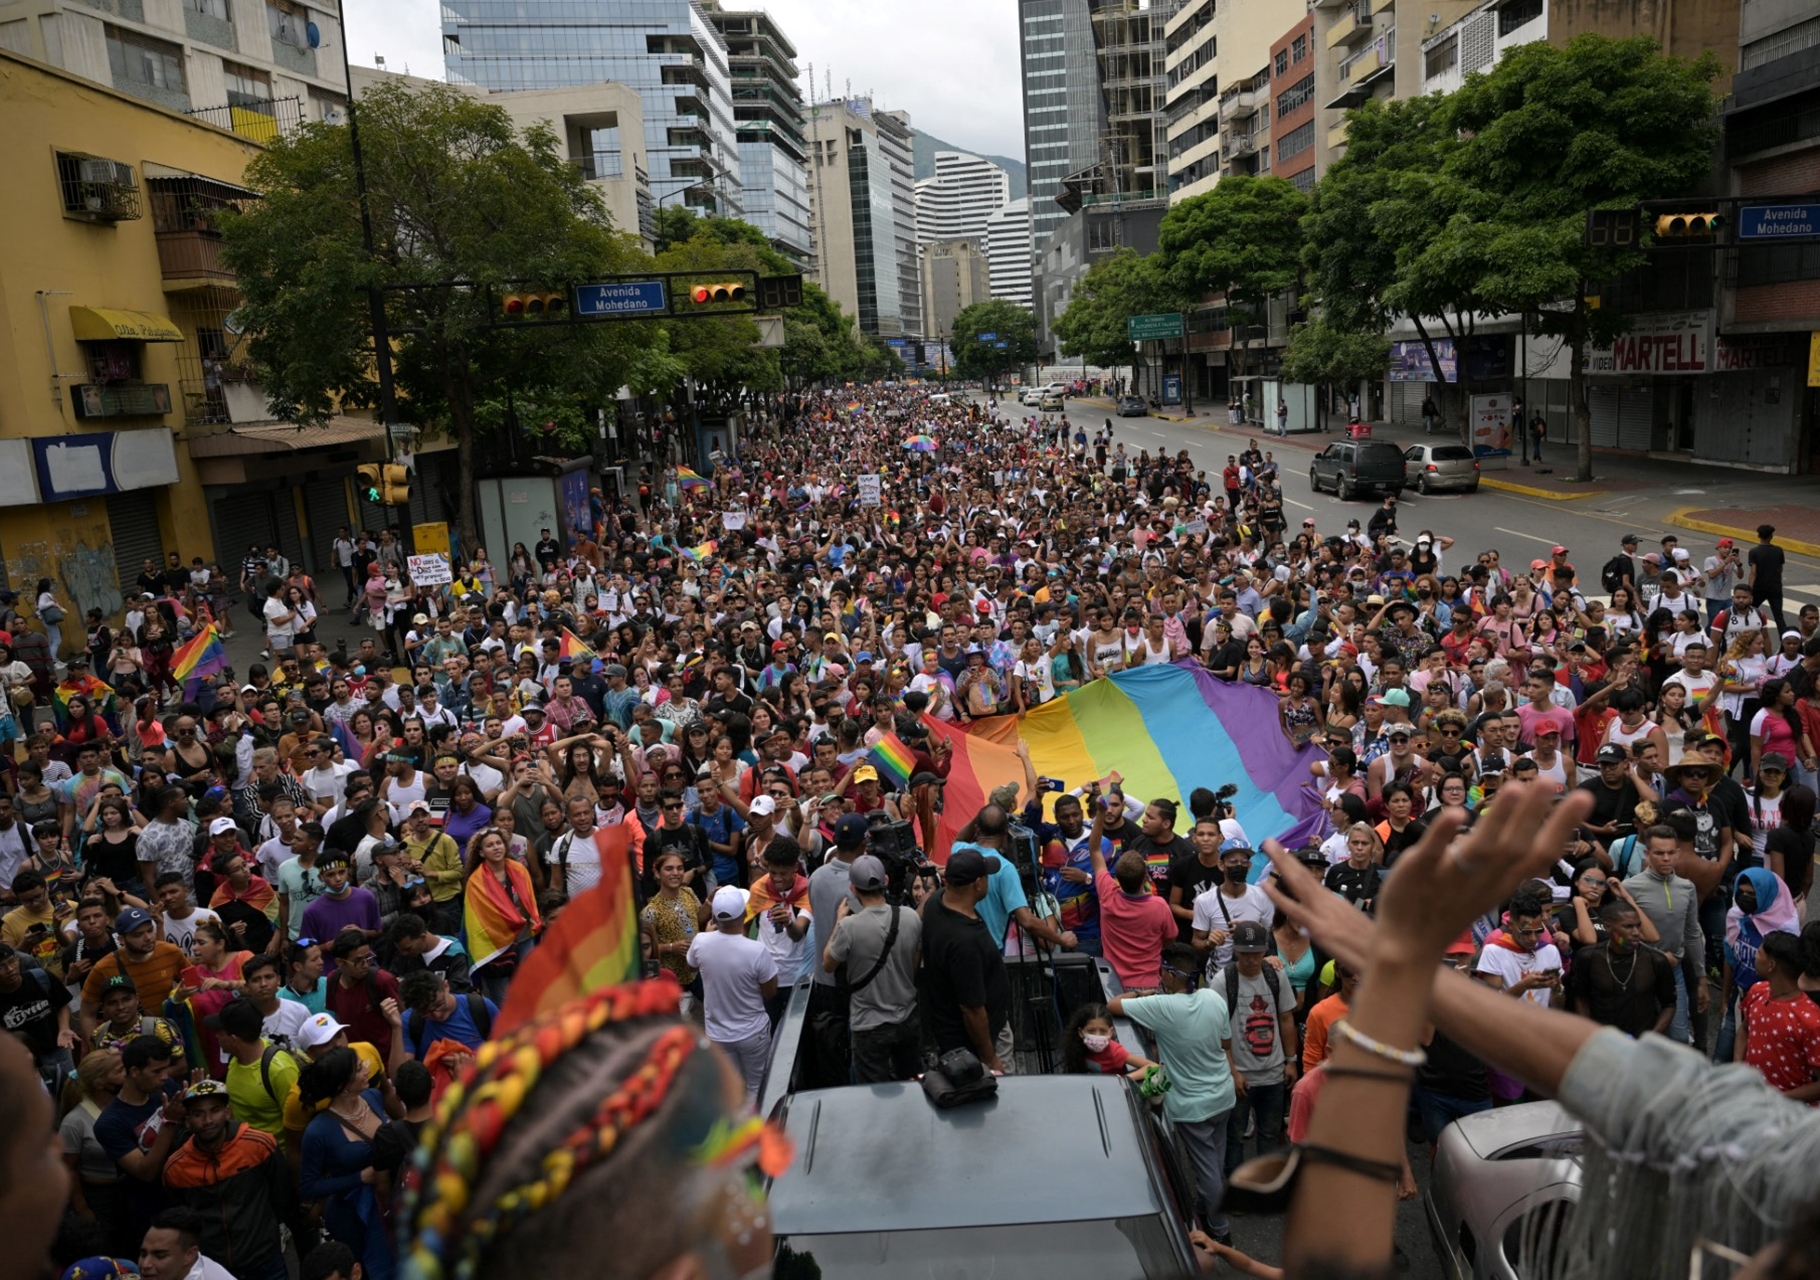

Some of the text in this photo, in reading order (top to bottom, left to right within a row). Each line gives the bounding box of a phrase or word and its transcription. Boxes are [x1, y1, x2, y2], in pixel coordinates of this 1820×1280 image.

[1764, 208, 1807, 220] Avenida
[1757, 222, 1812, 234] Mohedano
[600, 286, 641, 297] Avenida
[595, 299, 648, 310] Mohedano
[1593, 333, 1705, 371] VIDEO MARTELL
[410, 557, 421, 566] NO
[1731, 616, 1739, 625] 8
[131, 910, 140, 918] C
